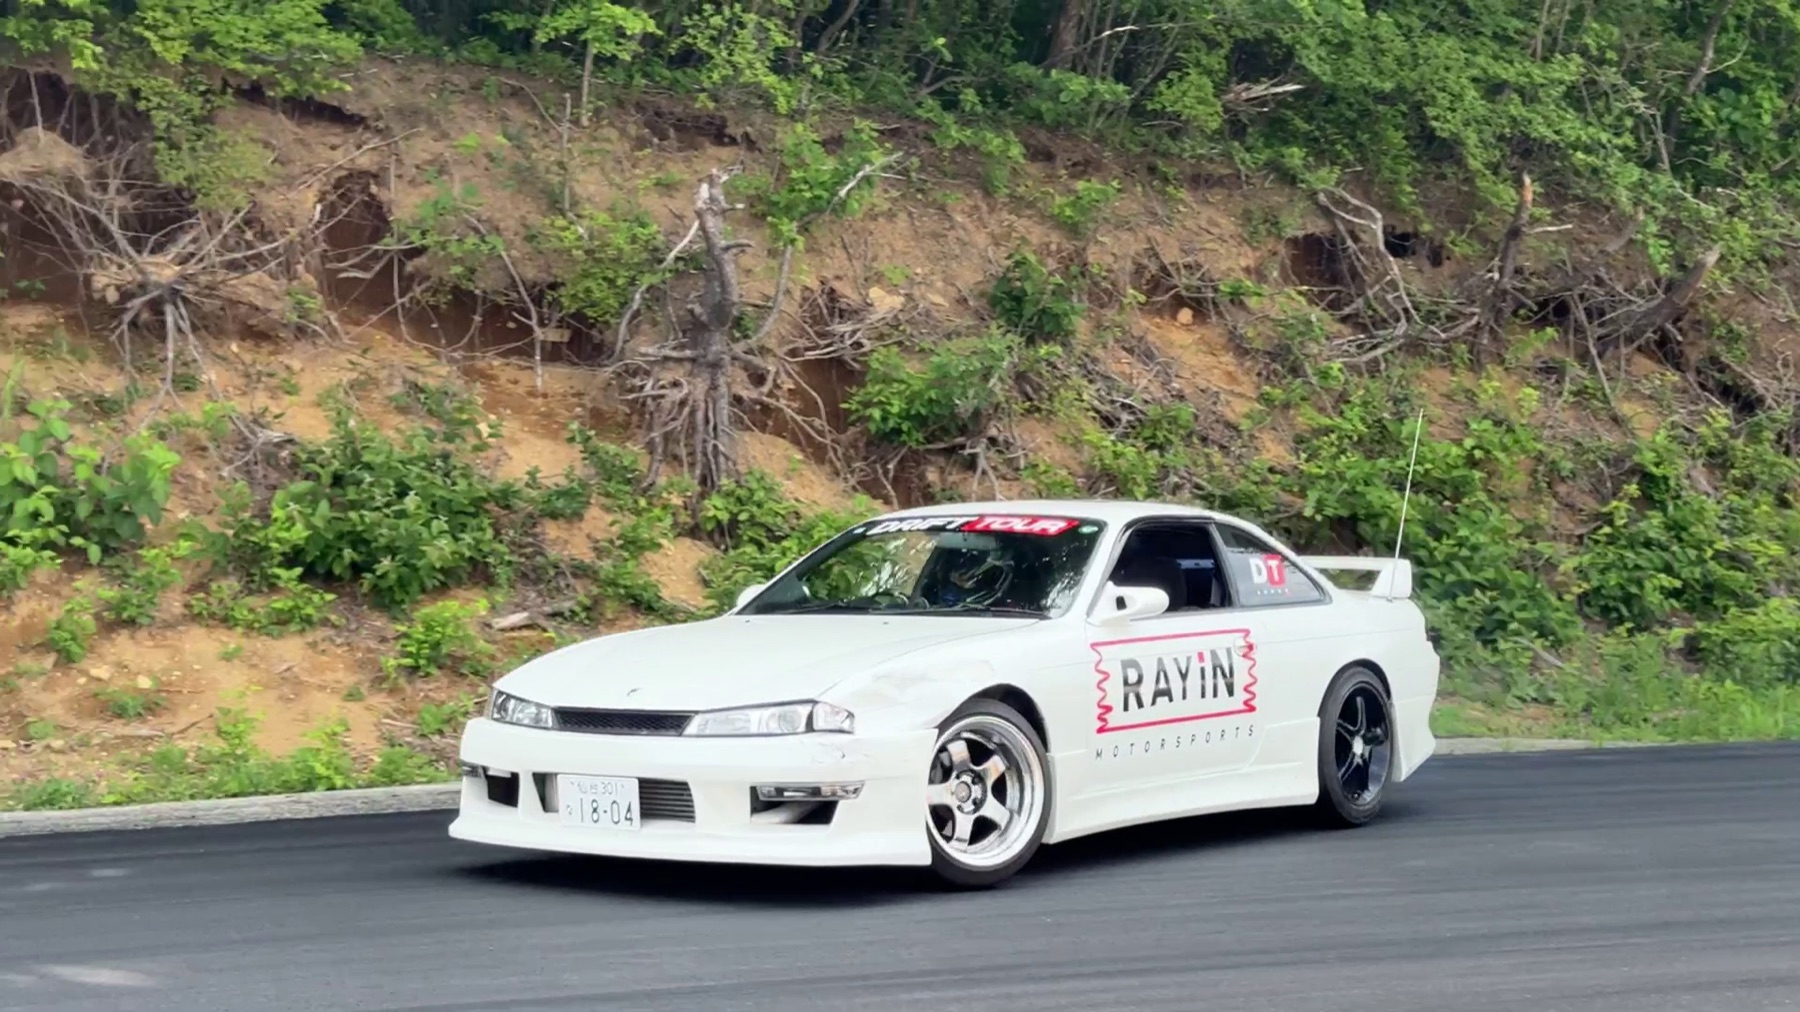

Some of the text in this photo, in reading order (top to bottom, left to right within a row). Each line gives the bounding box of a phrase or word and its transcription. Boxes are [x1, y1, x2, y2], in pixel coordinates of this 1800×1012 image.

[866, 517, 1069, 535] DRIFT TOUR
[1249, 559, 1281, 584] DT
[1095, 724, 1255, 760] MOTORSPORTS
[580, 797, 634, 826] 18-04
